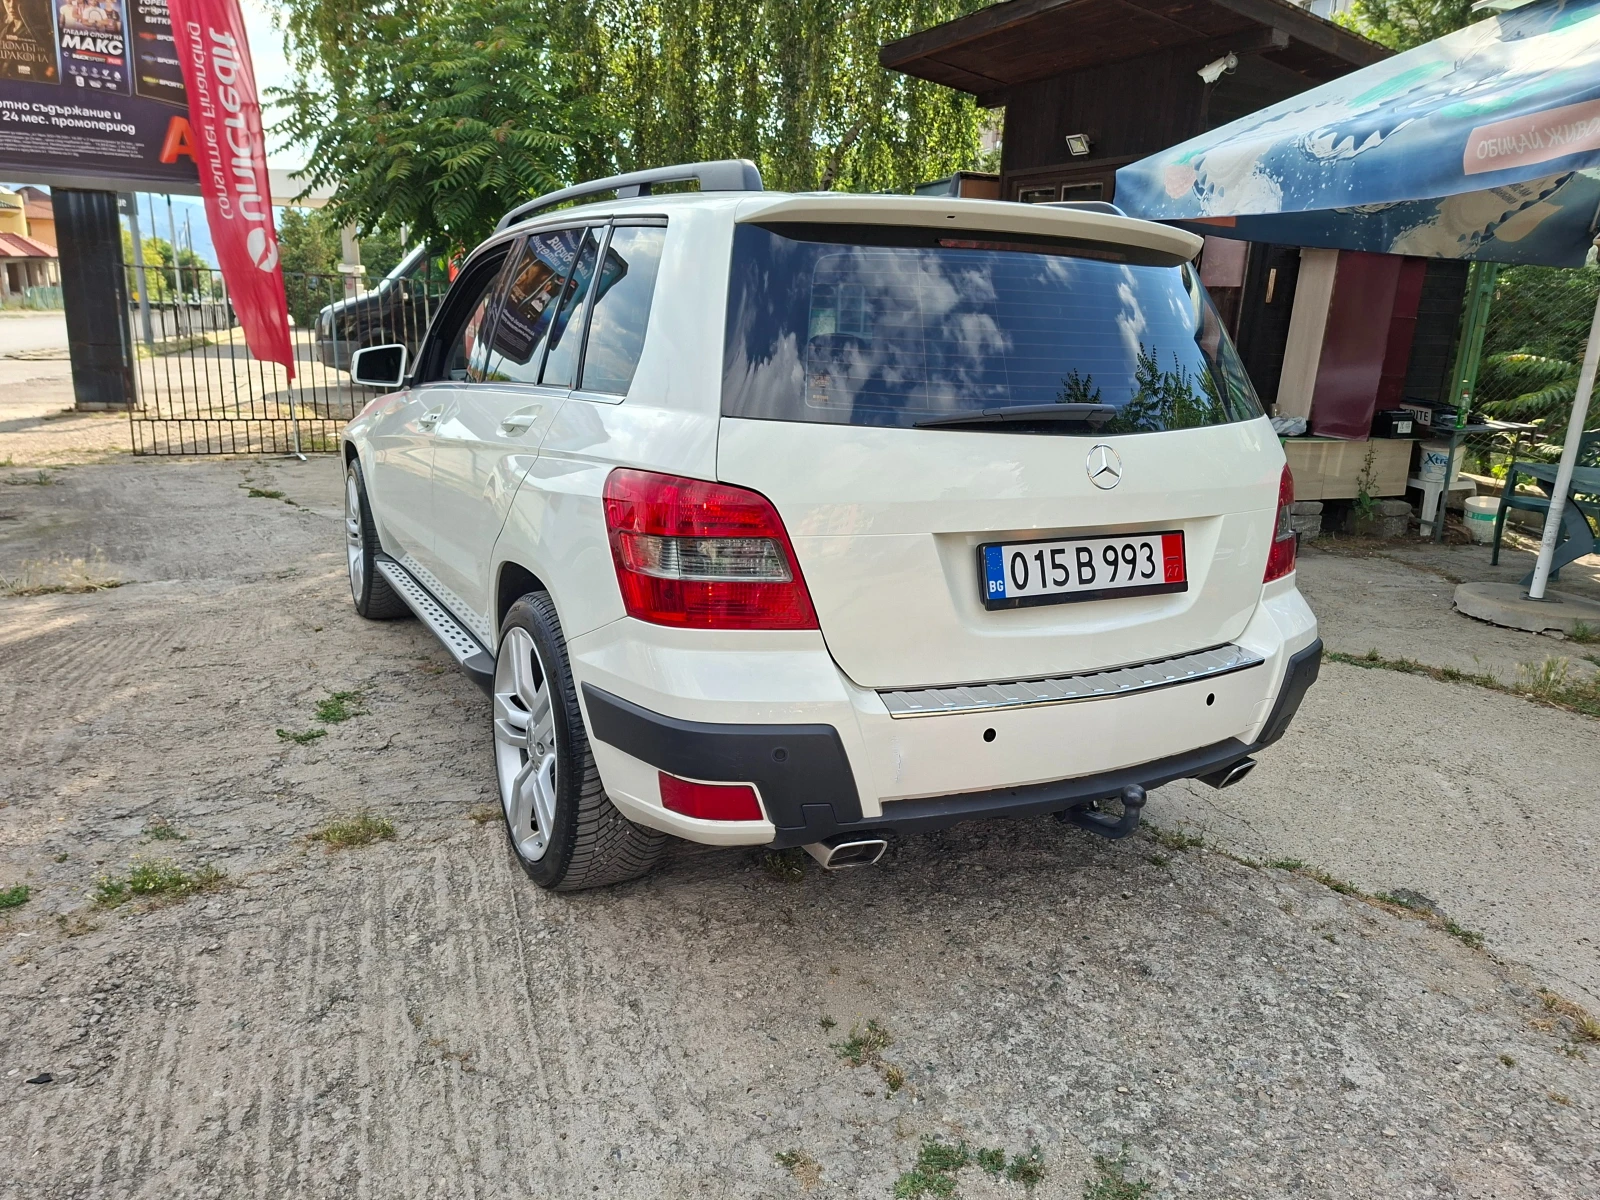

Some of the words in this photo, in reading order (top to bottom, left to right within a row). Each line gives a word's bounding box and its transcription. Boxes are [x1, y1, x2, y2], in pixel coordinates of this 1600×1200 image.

[63, 28, 89, 37] ГЛЕДАЙ
[90, 31, 112, 40] СПОРТ
[61, 34, 124, 56] МАКС
[32, 103, 112, 119] съдържание
[113, 111, 122, 120] и
[2, 110, 19, 122] 24
[21, 114, 49, 125] мес.
[51, 116, 136, 136] промопериод
[1477, 125, 1544, 159] ОБИЧАЙ
[1544, 116, 1600, 148] ЖИВО
[1405, 408, 1430, 422] DITE
[1010, 542, 1156, 591] 015B993
[989, 579, 1005, 593] BG
